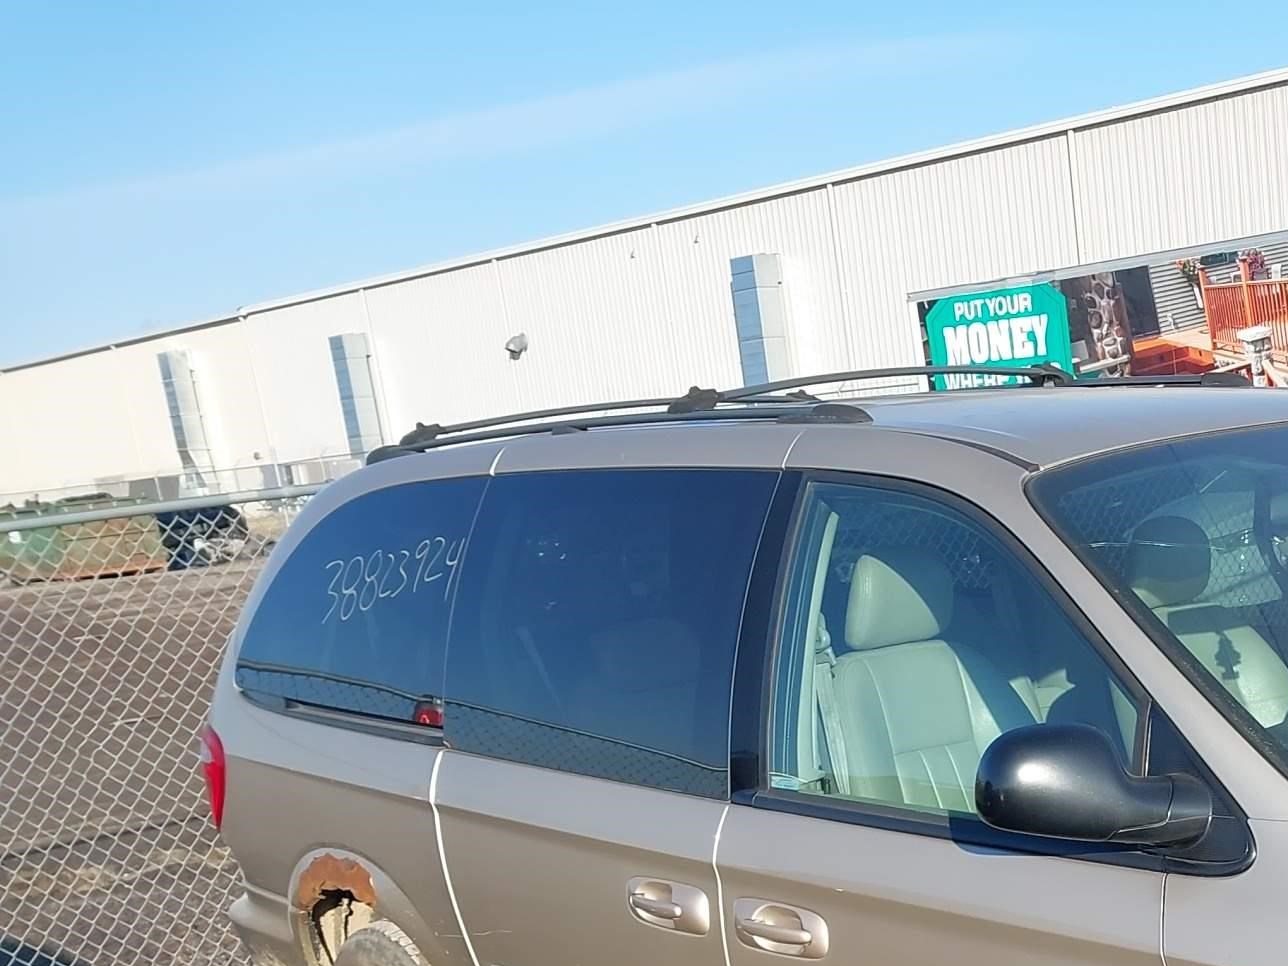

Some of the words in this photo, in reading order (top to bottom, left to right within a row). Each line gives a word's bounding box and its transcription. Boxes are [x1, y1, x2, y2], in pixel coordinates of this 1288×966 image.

[954, 299, 985, 321] PUT
[986, 293, 1032, 317] YOUR
[942, 313, 1048, 366] MONEY
[321, 536, 465, 624] 38823924
